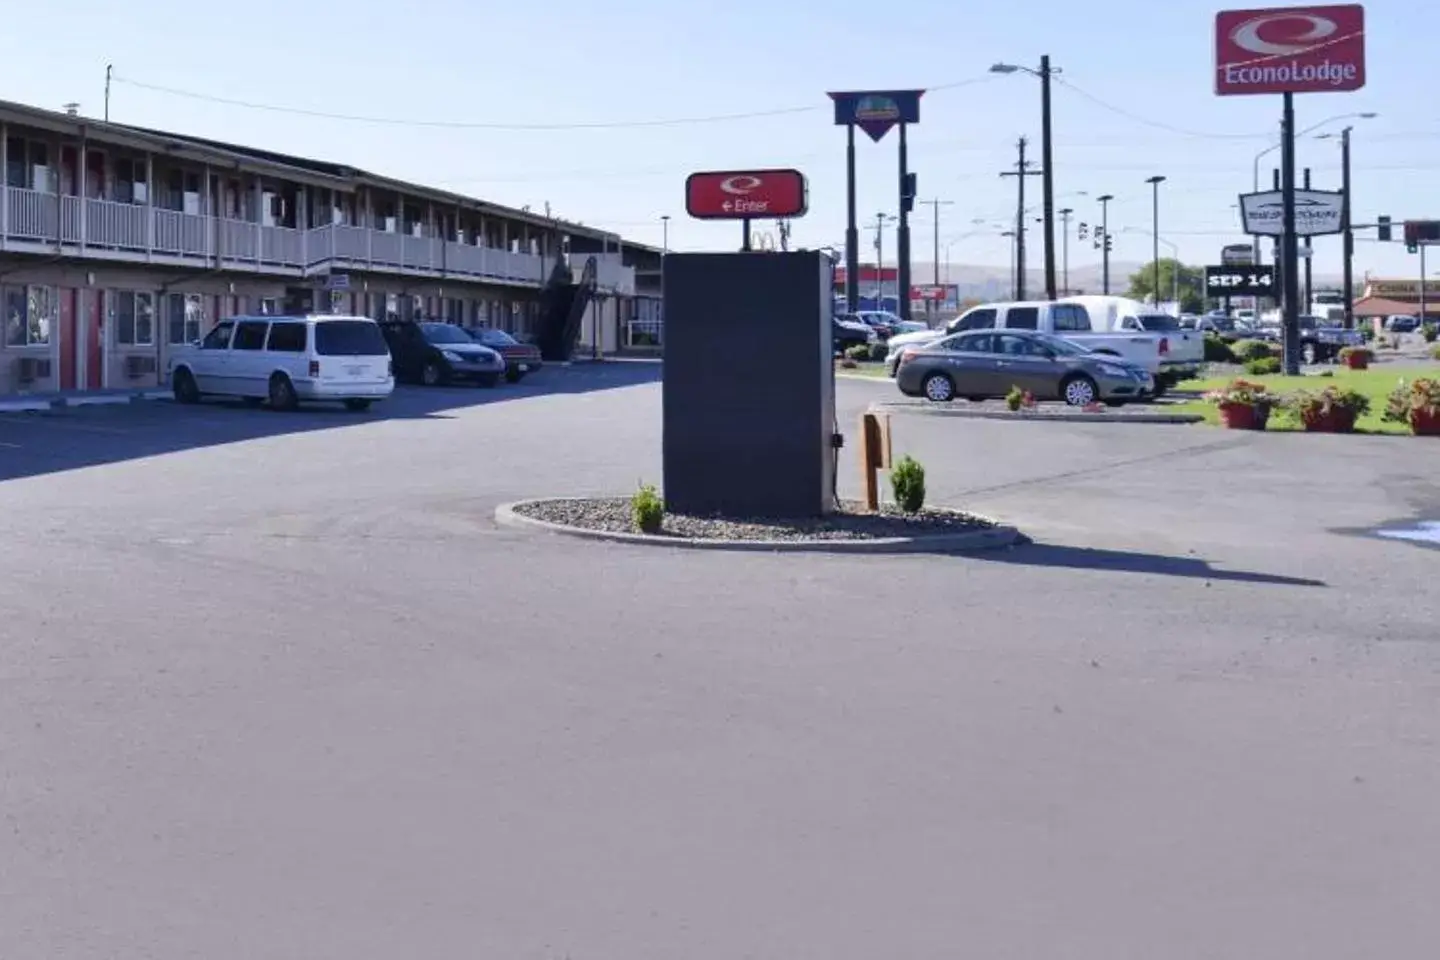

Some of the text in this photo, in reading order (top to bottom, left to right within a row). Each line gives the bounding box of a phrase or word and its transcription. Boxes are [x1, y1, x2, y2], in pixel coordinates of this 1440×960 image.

[1225, 58, 1357, 86] EconoLodge
[734, 199, 769, 213] Enter
[1208, 274, 1271, 287] SEP 14
